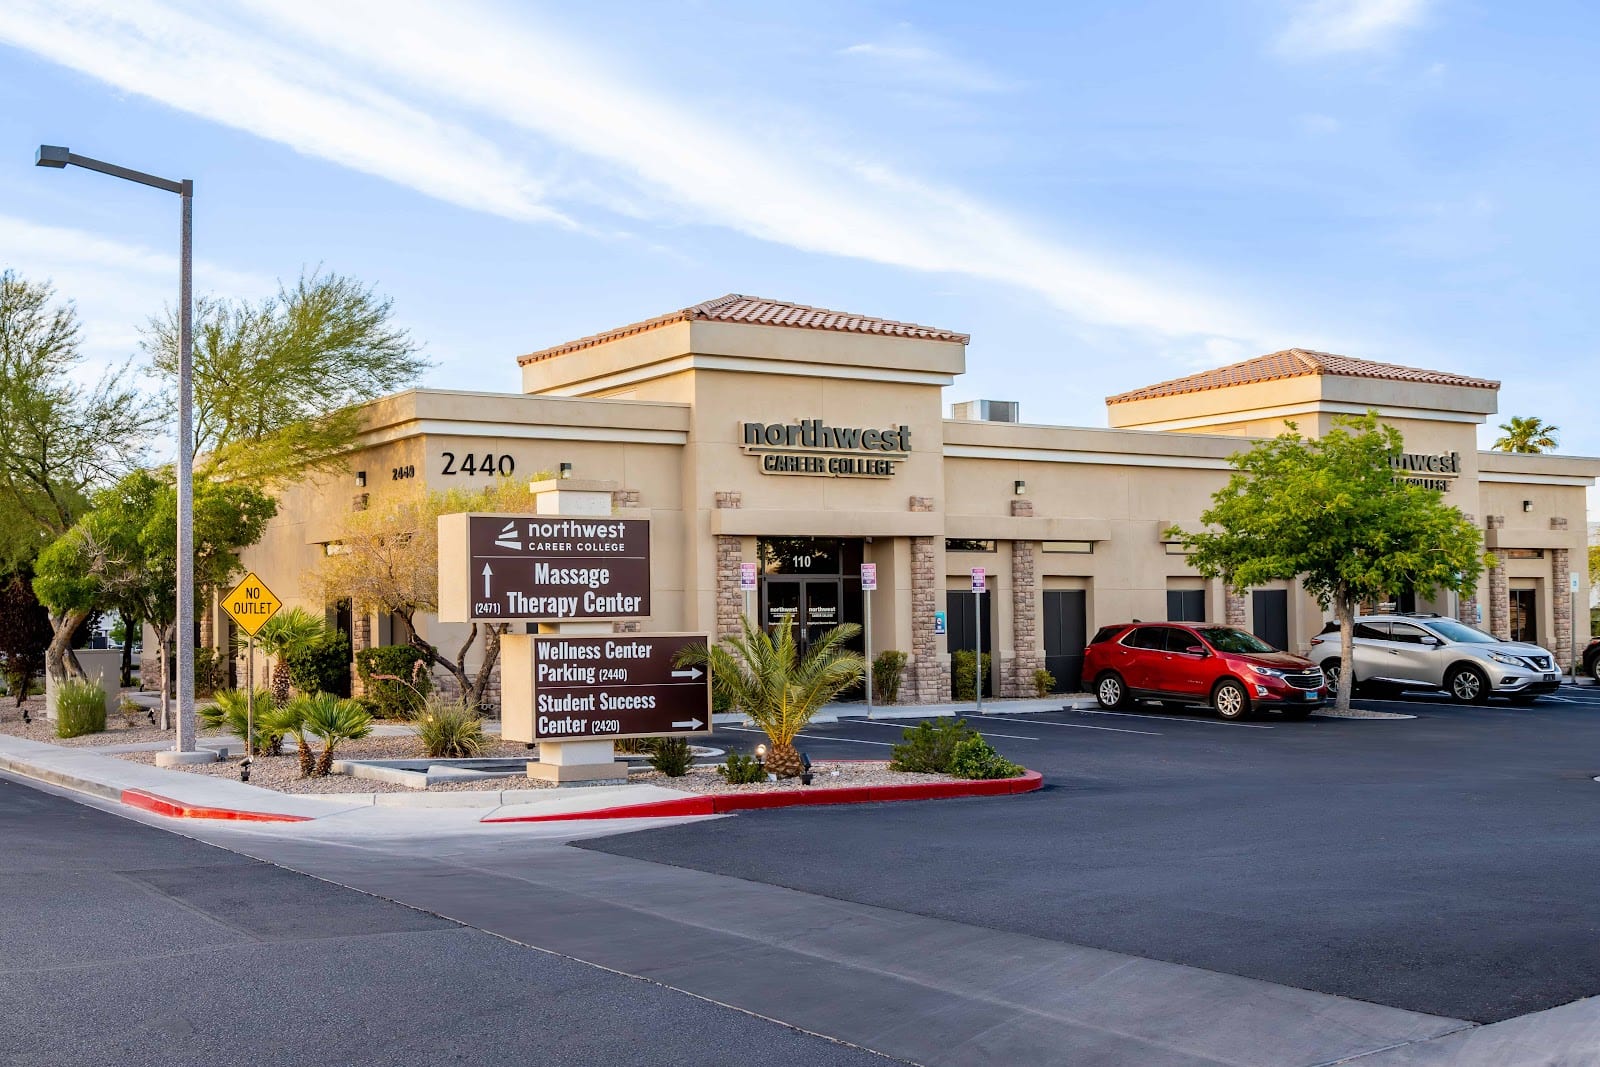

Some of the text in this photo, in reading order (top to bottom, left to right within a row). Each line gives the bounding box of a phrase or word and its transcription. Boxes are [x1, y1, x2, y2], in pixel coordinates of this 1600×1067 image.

[744, 418, 912, 451] northwest
[441, 452, 515, 478] 2440
[764, 454, 895, 476] CAREER COLLEGE
[1387, 448, 1461, 473] thwest
[392, 464, 415, 480] 2440
[528, 520, 626, 539] northwest
[528, 542, 625, 552] CAREER COLLEGE
[793, 555, 811, 568] 110
[534, 562, 610, 588] Massage
[246, 587, 260, 600] NO
[233, 602, 272, 615] OUTLET
[475, 602, 501, 615] (2471)
[506, 591, 642, 618] Therapy Center
[537, 641, 652, 661] Wellness Center
[538, 663, 628, 683] Parking (2440)
[538, 692, 656, 713] Student Success
[538, 715, 620, 735] Center (2420)
